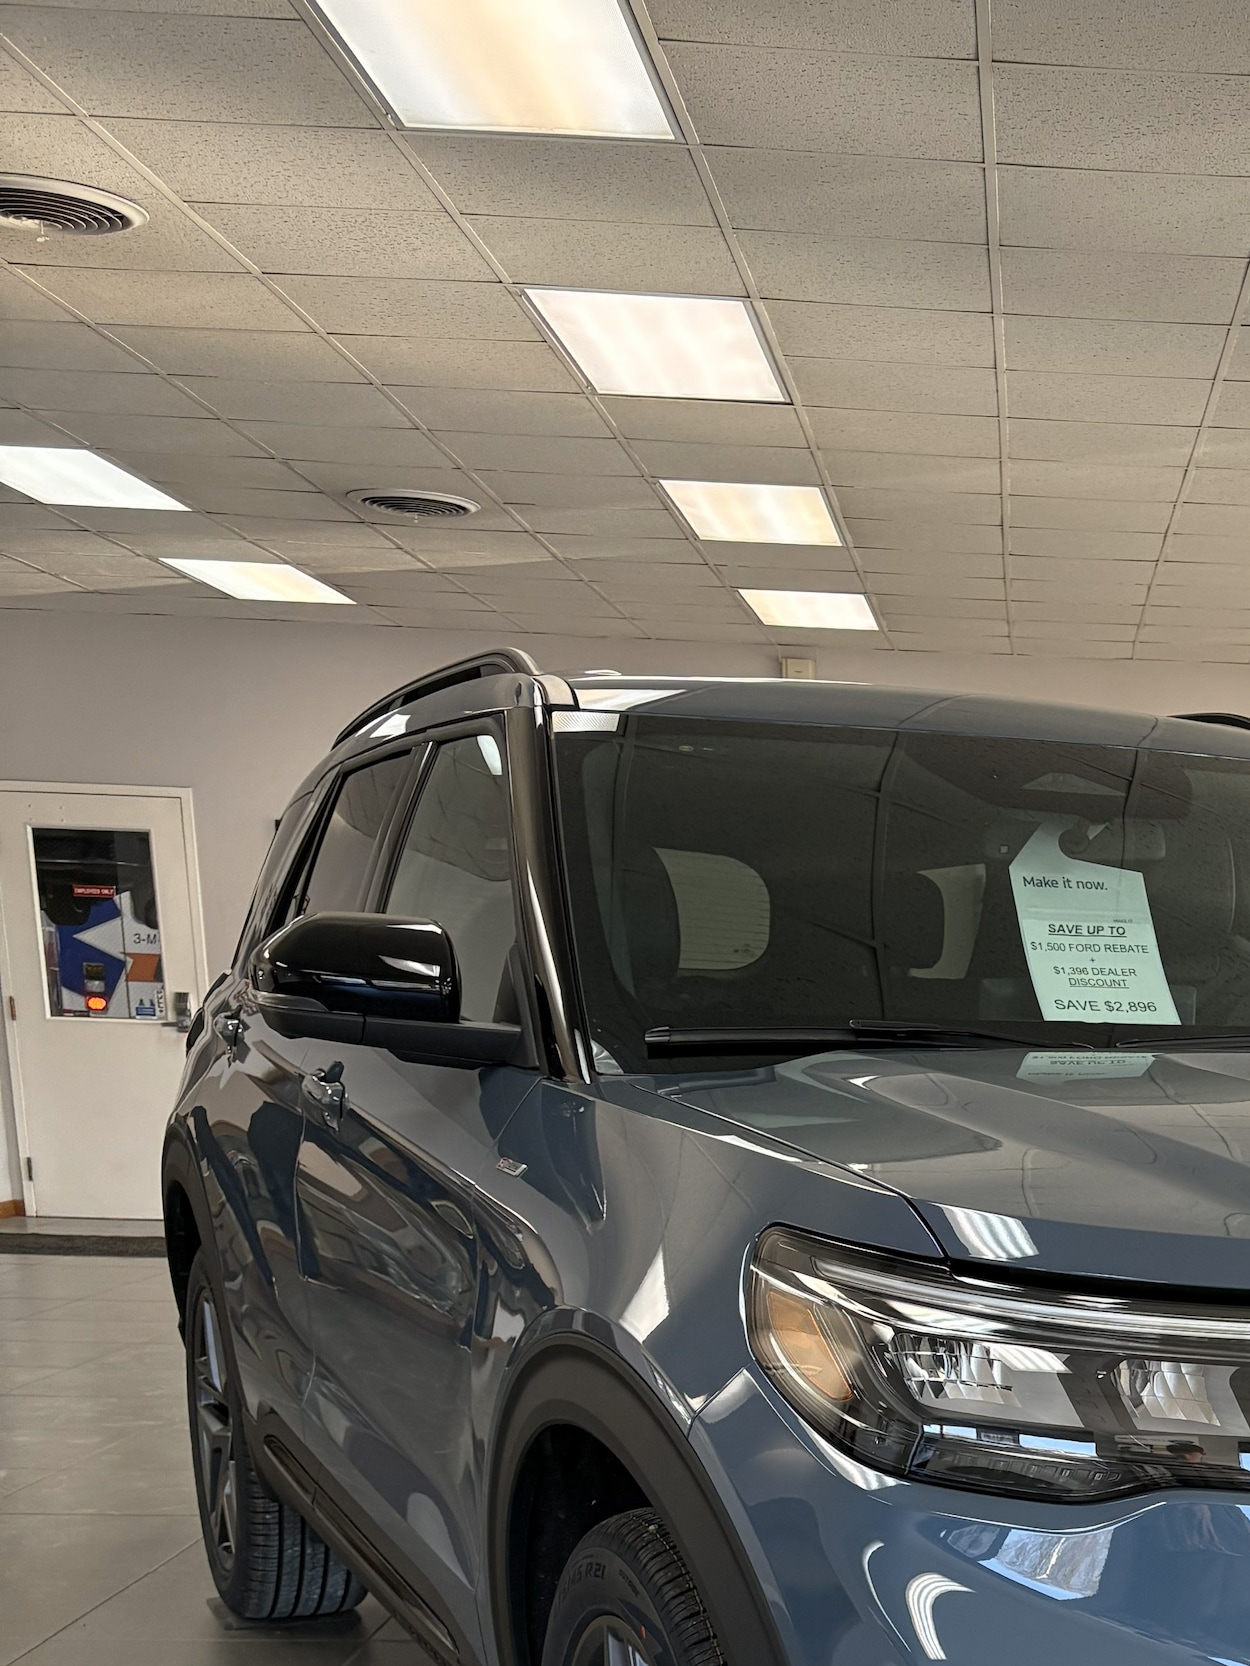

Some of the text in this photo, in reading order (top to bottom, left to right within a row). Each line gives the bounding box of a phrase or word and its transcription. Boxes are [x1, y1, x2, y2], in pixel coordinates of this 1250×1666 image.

[1022, 876, 1108, 891] Make it now.
[1048, 924, 1126, 935] SAVE UP TO
[1030, 941, 1150, 954] $1,500 FORD REBATE
[1053, 966, 1137, 977] $1,396 DEALER
[1068, 977, 1128, 987] DISCOUNT
[1054, 999, 1157, 1013] SAVE $2,896
